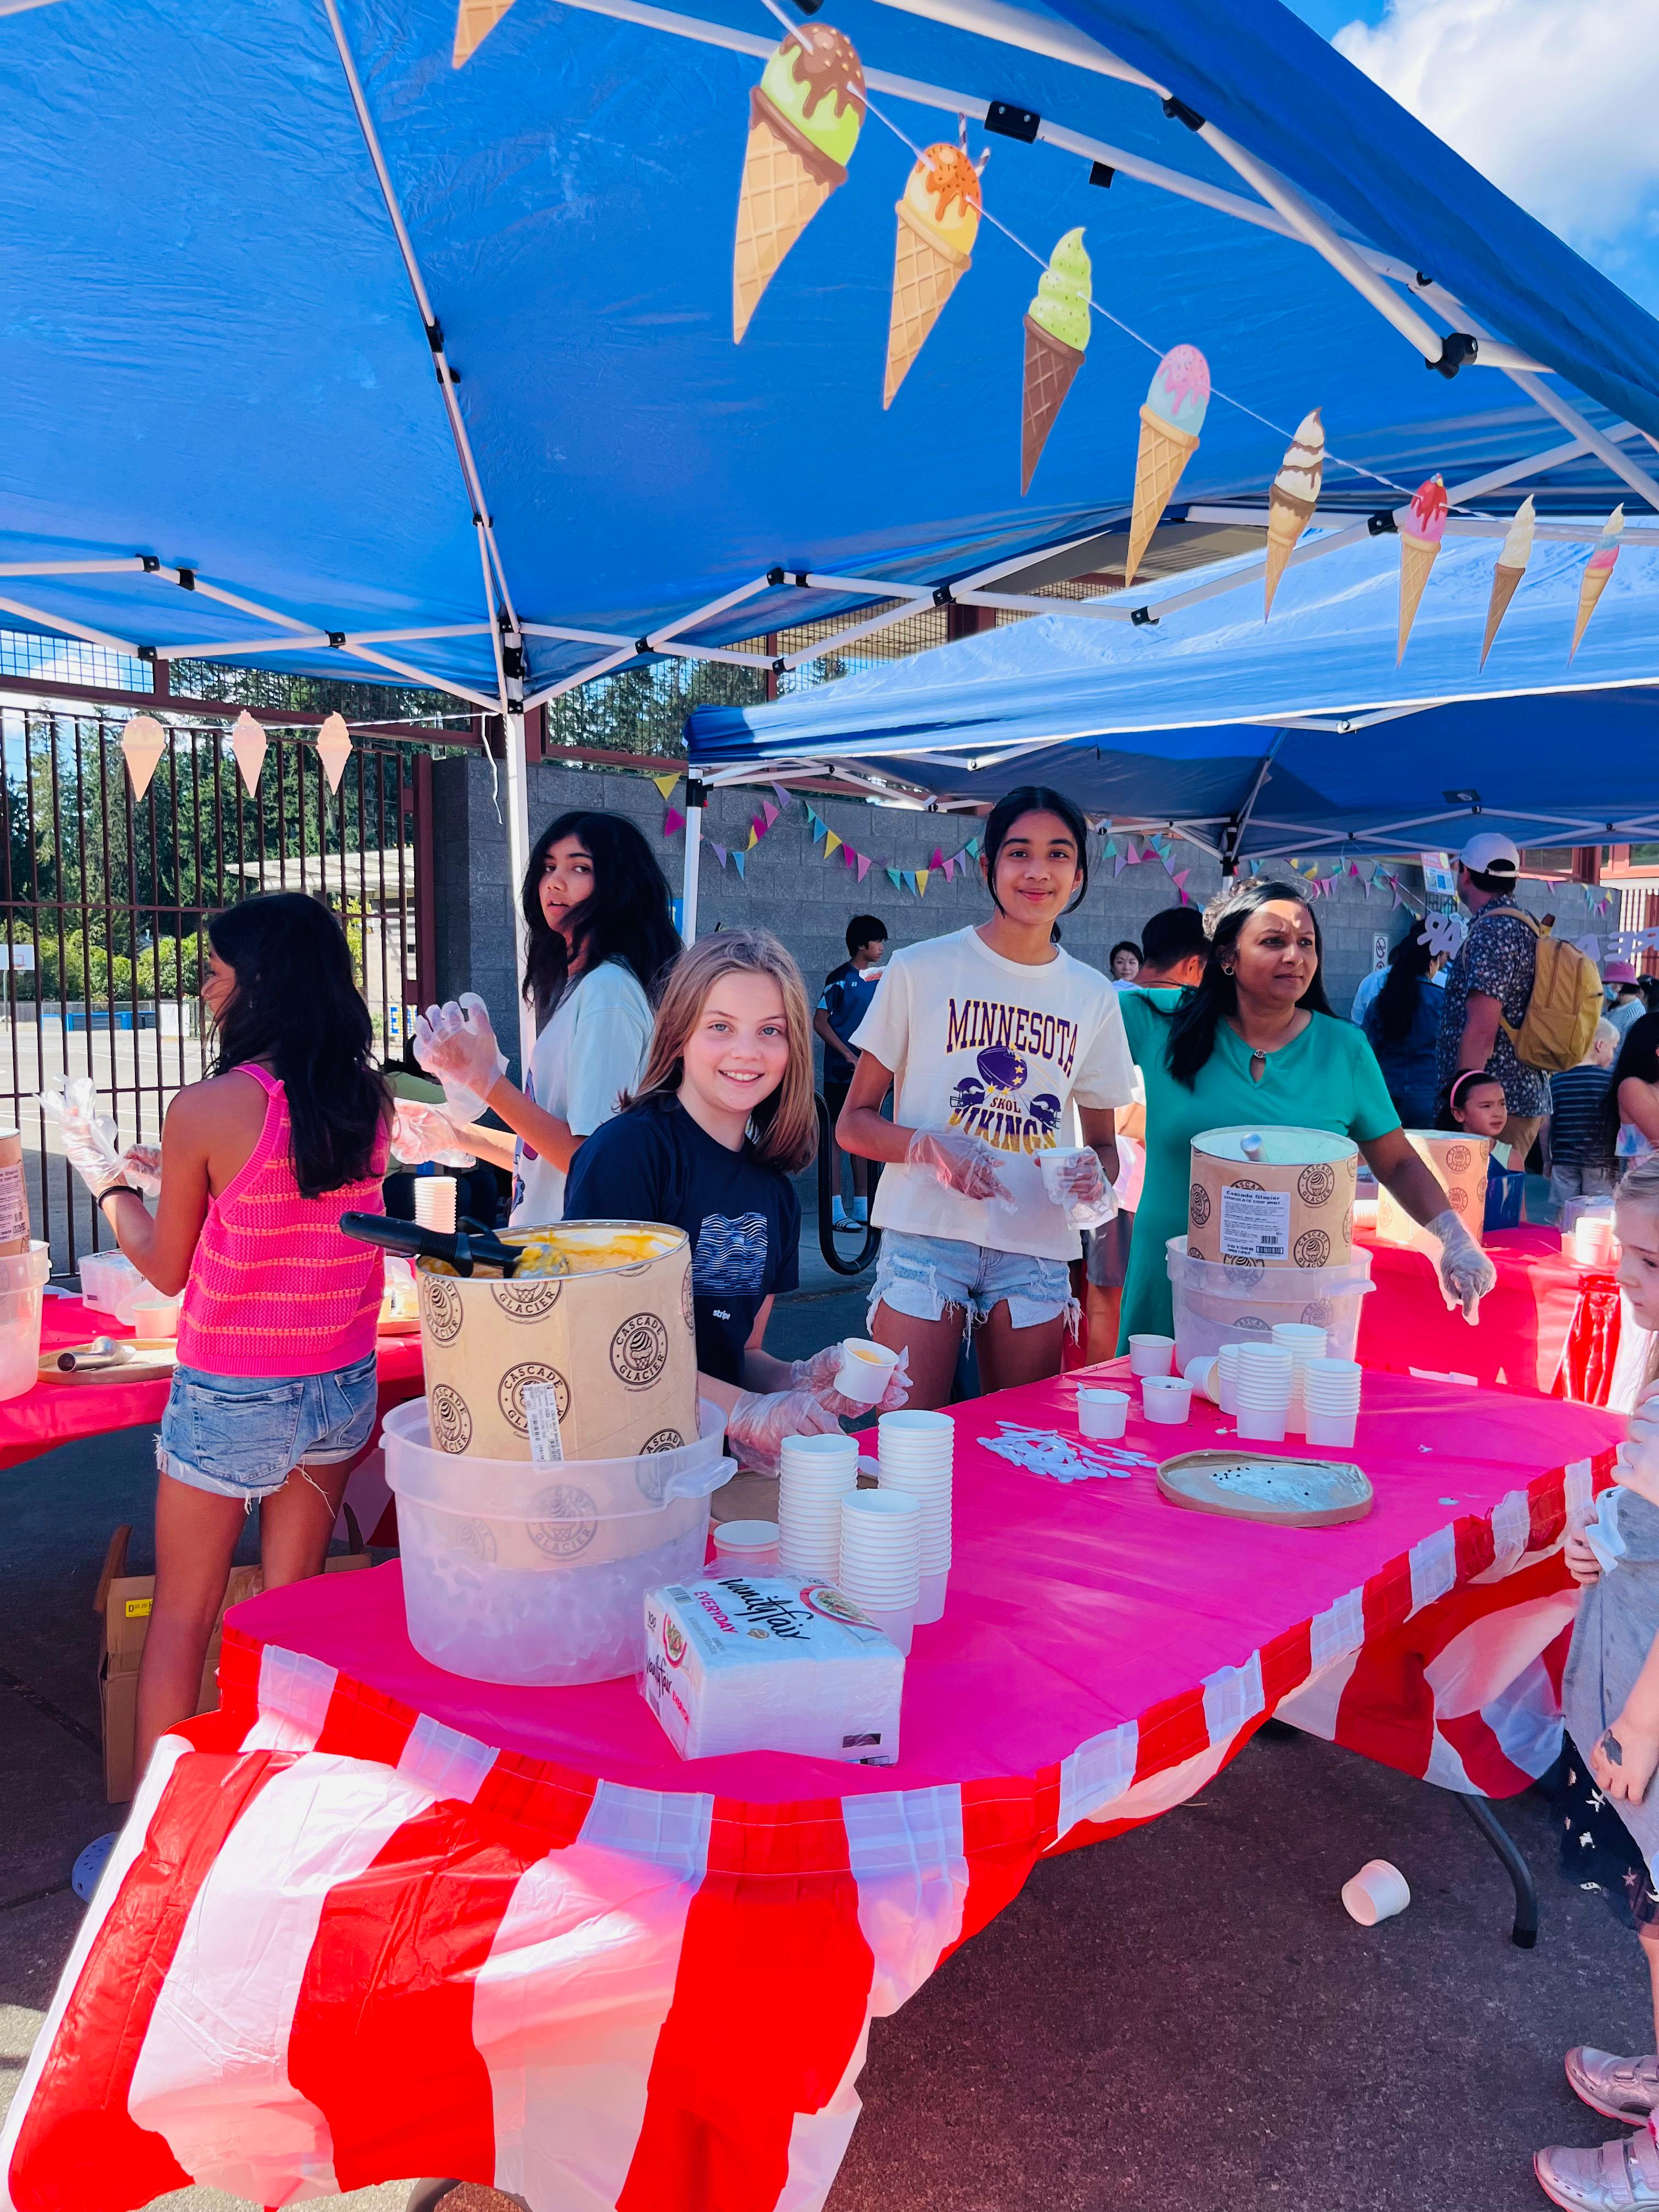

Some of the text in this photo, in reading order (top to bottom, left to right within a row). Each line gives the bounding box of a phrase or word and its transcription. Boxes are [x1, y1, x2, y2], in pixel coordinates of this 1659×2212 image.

[946, 998, 1078, 1079] MINNESOTA
[990, 1097, 1021, 1113] SKOL
[1302, 1164, 1334, 1180] CASCADE
[1302, 1188, 1331, 1202] GLACIER
[1298, 1231, 1328, 1246] CASCADE
[1298, 1255, 1327, 1268] GLACIER
[499, 1291, 555, 1313] GLACIER
[616, 1317, 664, 1345] CASCADE
[504, 1366, 563, 1389] CASCADE
[619, 1354, 664, 1380] GLACIER
[646, 1432, 685, 1454] ASCADE
[693, 1591, 738, 1633] EVERYDAY
